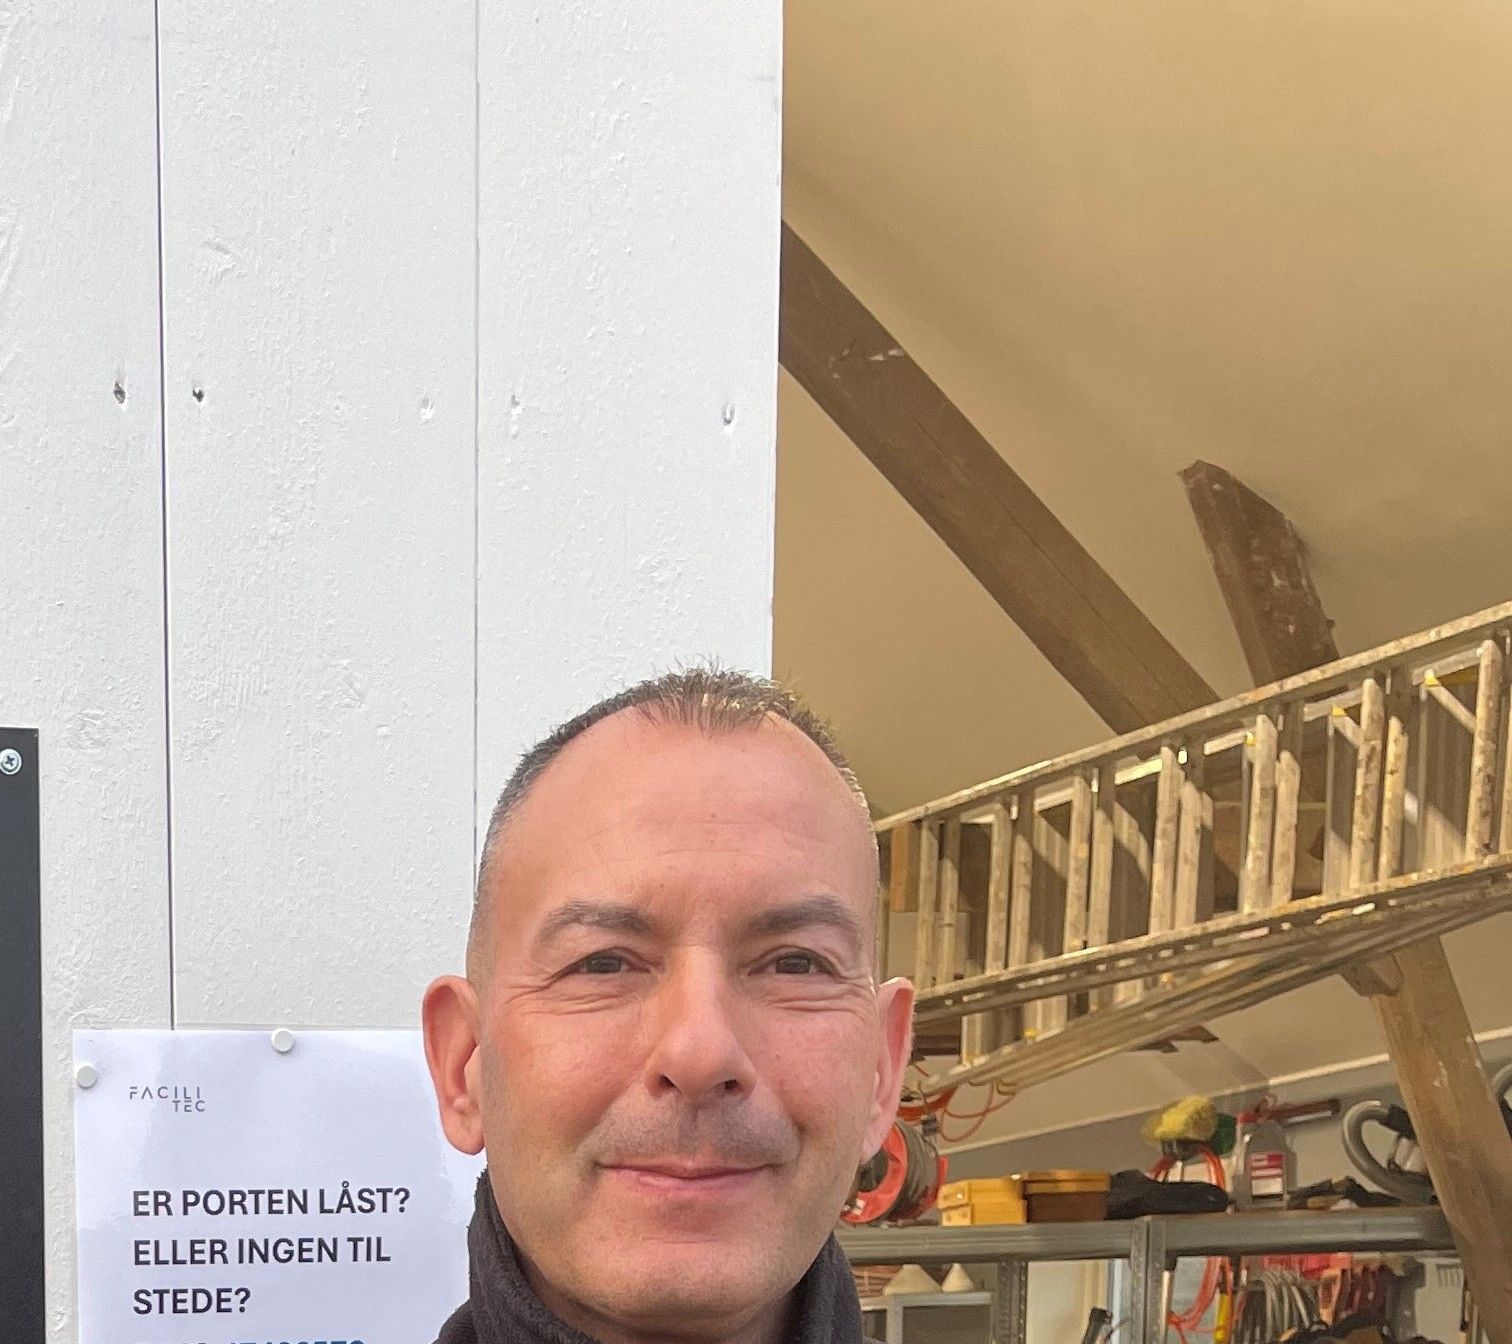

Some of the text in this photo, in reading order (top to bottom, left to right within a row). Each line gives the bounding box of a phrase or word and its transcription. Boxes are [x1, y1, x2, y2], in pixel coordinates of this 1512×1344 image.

[129, 1085, 201, 1100] FACILI
[171, 1099, 206, 1113] TEC
[133, 1180, 411, 1217] ER PORTEN LÅST?
[134, 1236, 391, 1266] ELLER INGEN TIL
[133, 1287, 251, 1315] STEDE?
